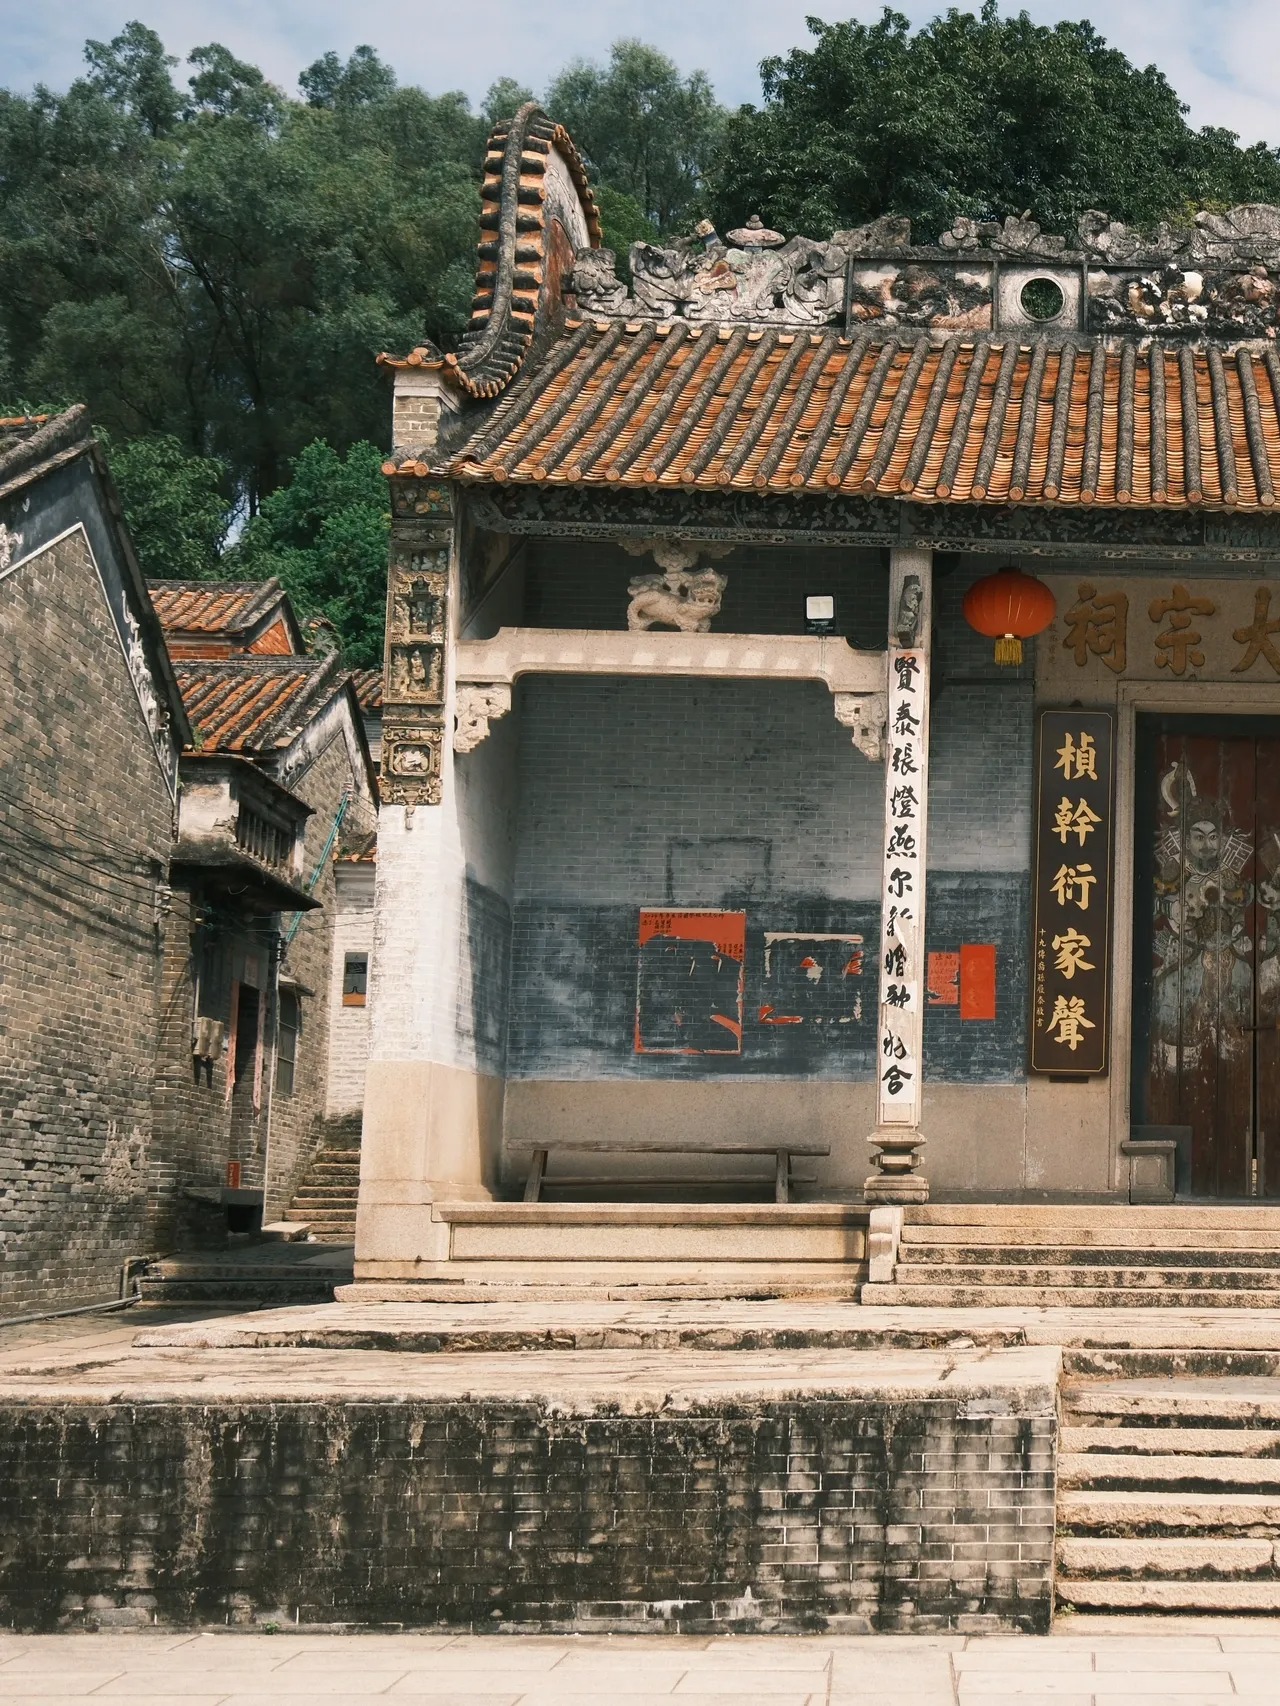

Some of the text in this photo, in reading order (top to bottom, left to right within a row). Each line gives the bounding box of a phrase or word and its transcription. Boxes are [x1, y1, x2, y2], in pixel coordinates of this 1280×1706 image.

[1045, 731, 1103, 1051] 楨幹衍家聲
